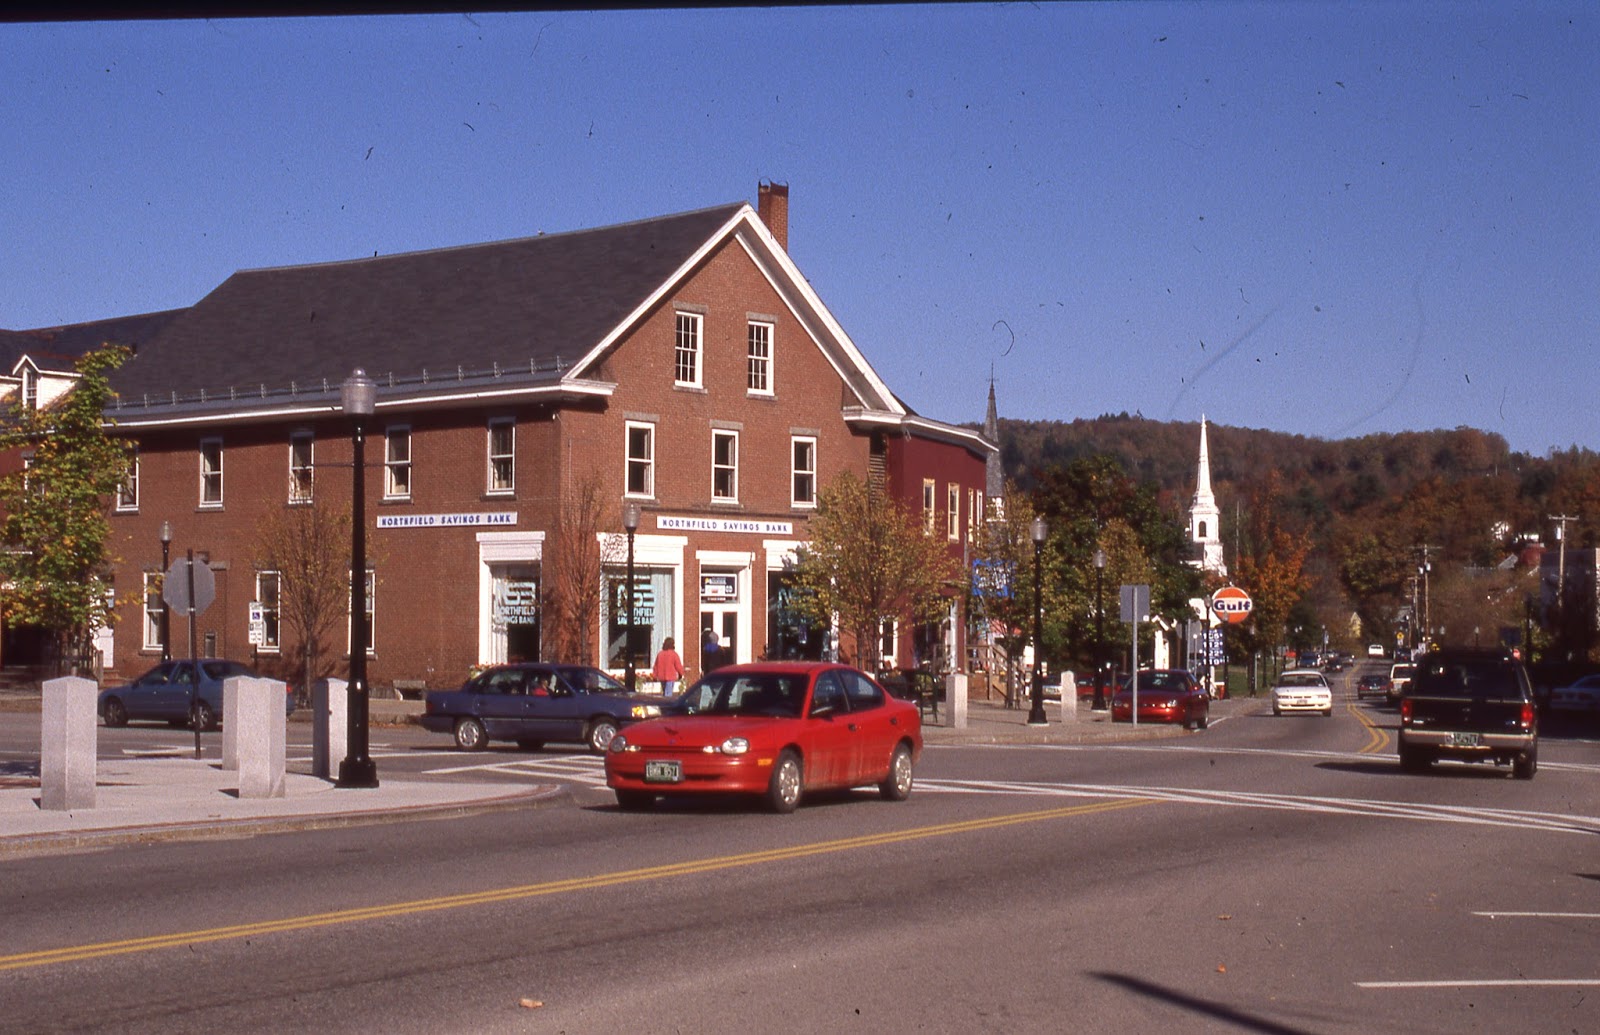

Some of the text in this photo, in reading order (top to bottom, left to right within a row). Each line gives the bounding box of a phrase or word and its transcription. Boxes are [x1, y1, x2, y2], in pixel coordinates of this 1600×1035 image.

[381, 514, 511, 526] NORTHFIELD SAVINGS BANK
[662, 519, 788, 532] NORTHFIELD SAVINGS BANK
[1214, 600, 1250, 611] Gulf
